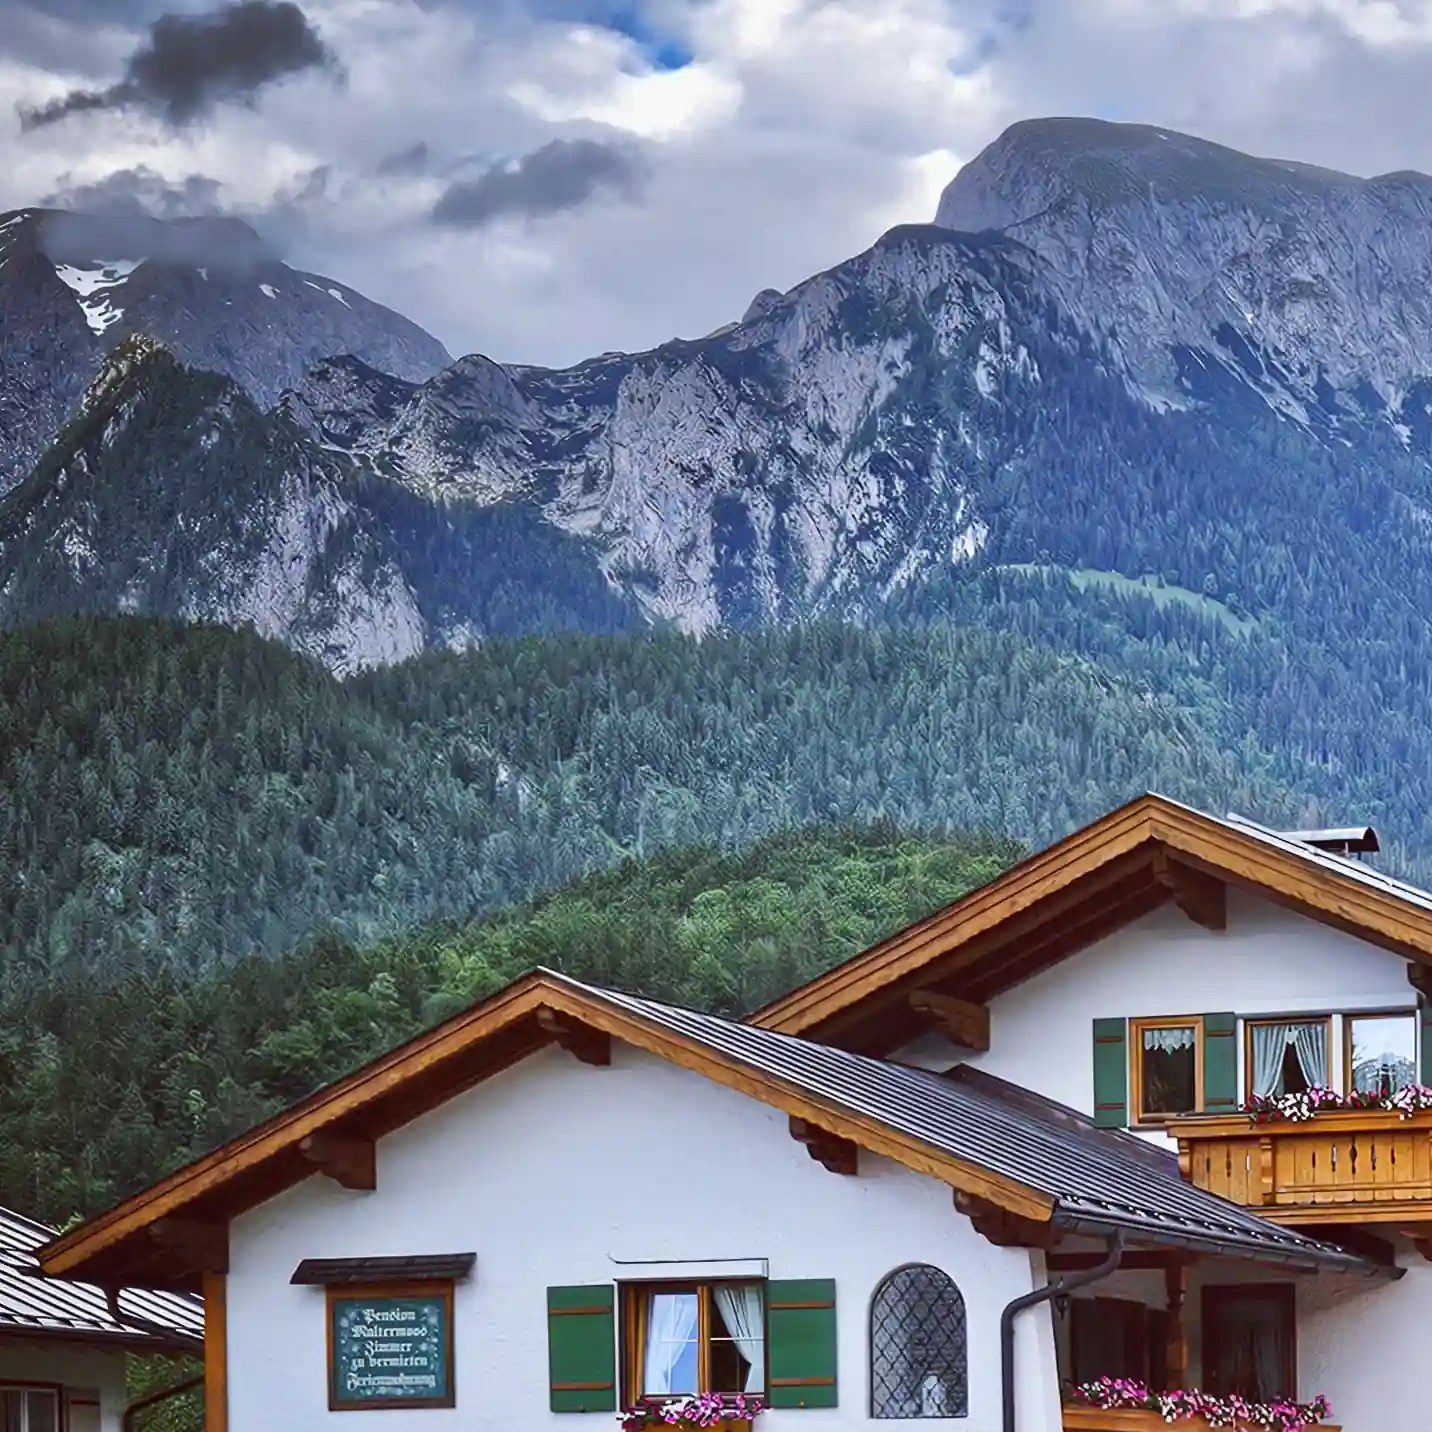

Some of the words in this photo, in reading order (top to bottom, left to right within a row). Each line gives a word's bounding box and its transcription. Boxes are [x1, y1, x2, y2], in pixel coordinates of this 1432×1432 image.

[363, 1307, 416, 1324] Pension
[364, 1340, 412, 1356] Zimmer
[350, 1357, 365, 1371] zu
[368, 1354, 428, 1367] vermieten
